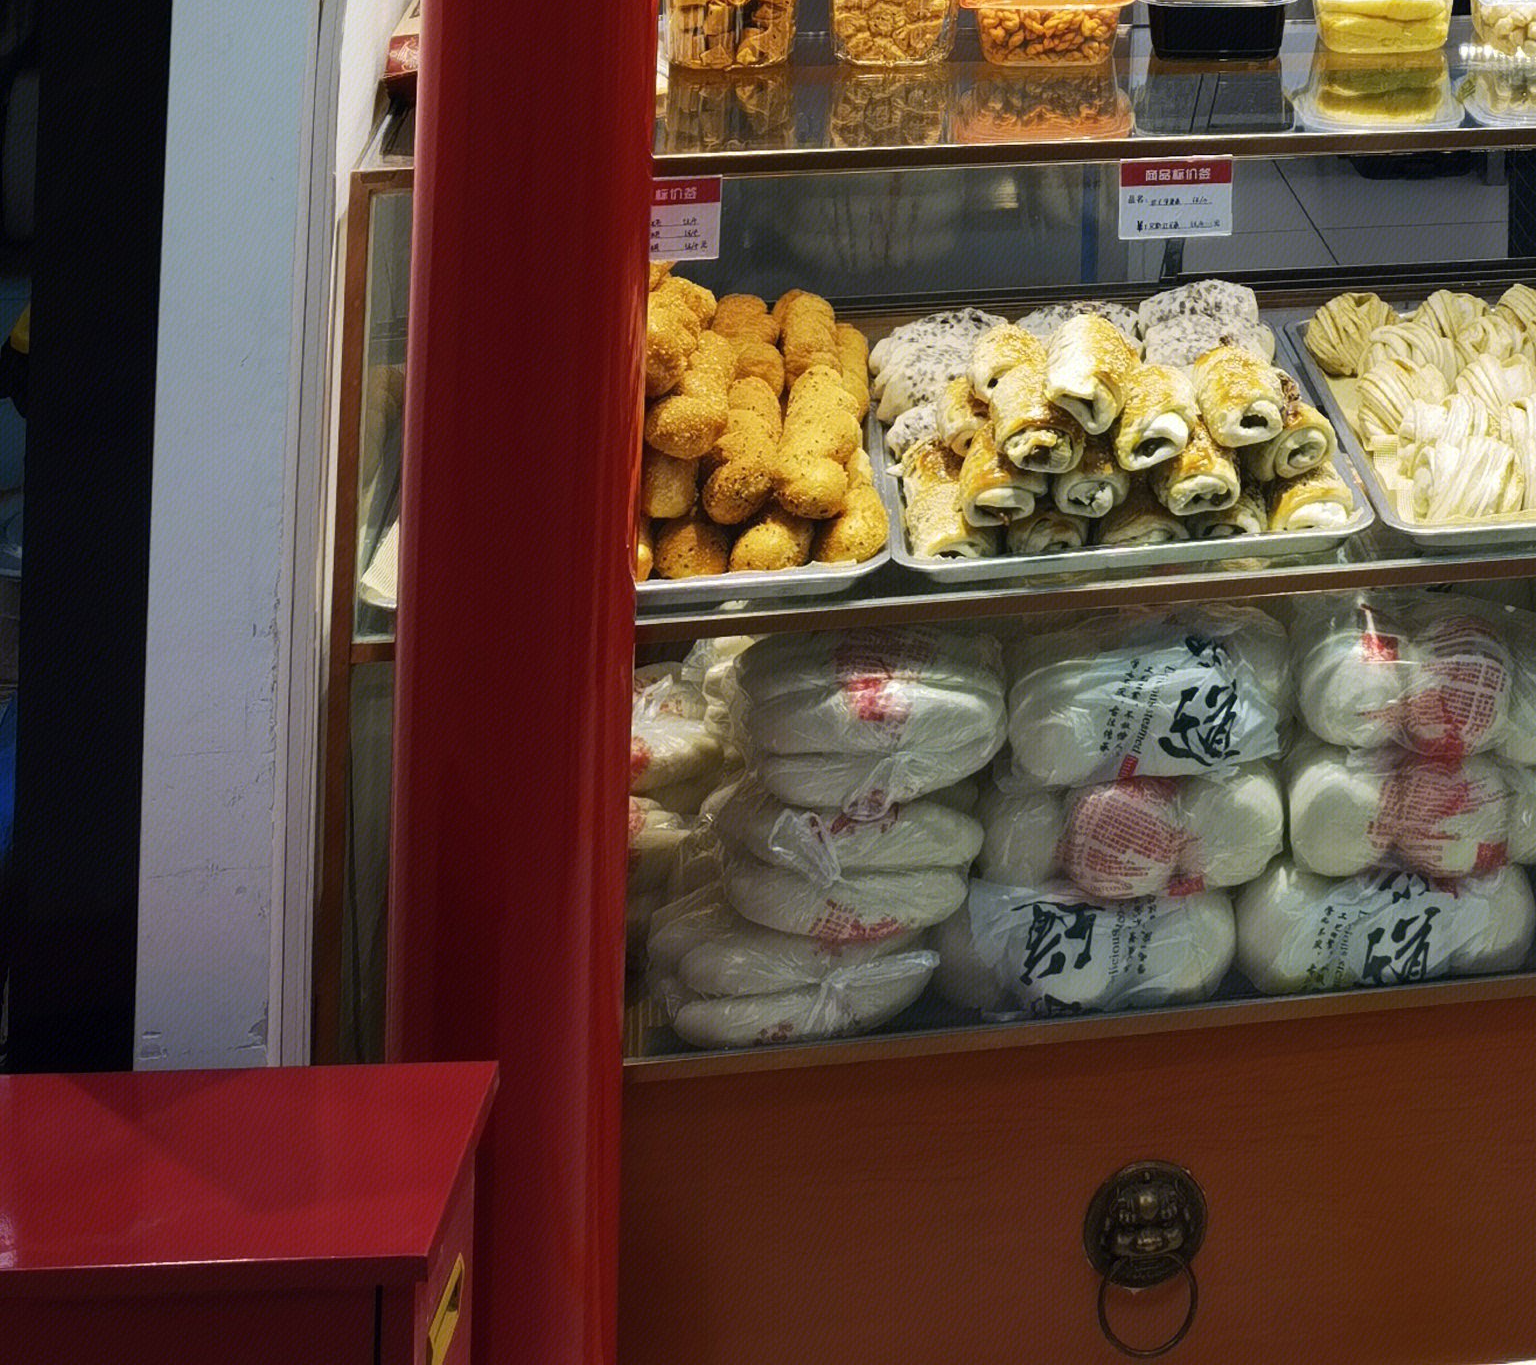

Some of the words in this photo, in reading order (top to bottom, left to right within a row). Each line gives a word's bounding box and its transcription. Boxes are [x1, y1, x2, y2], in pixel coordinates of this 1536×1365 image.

[1144, 167, 1212, 182] 商品标价签
